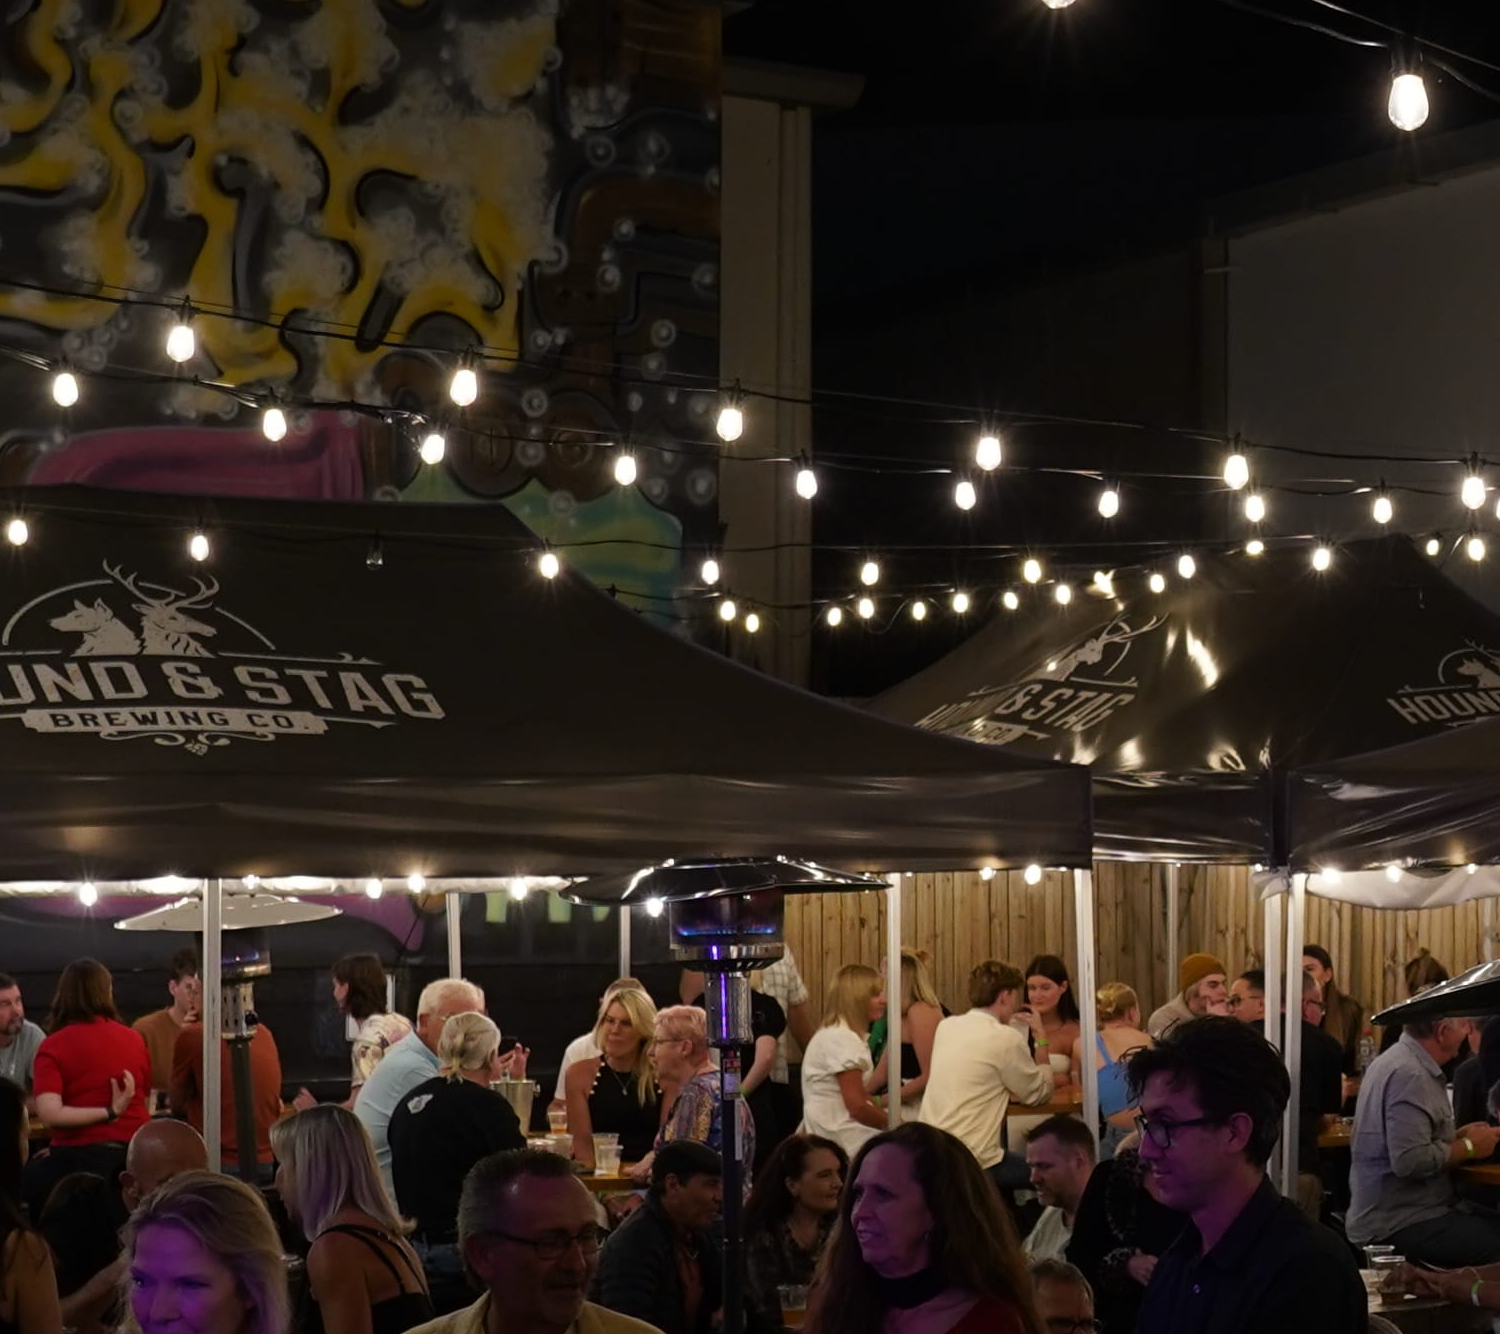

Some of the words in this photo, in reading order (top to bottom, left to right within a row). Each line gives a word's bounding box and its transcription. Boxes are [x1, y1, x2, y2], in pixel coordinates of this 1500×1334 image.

[160, 661, 225, 701] &
[232, 664, 447, 721] STAG
[994, 682, 1044, 715] &
[1020, 687, 1136, 732] STAG
[52, 709, 230, 730] BREWING
